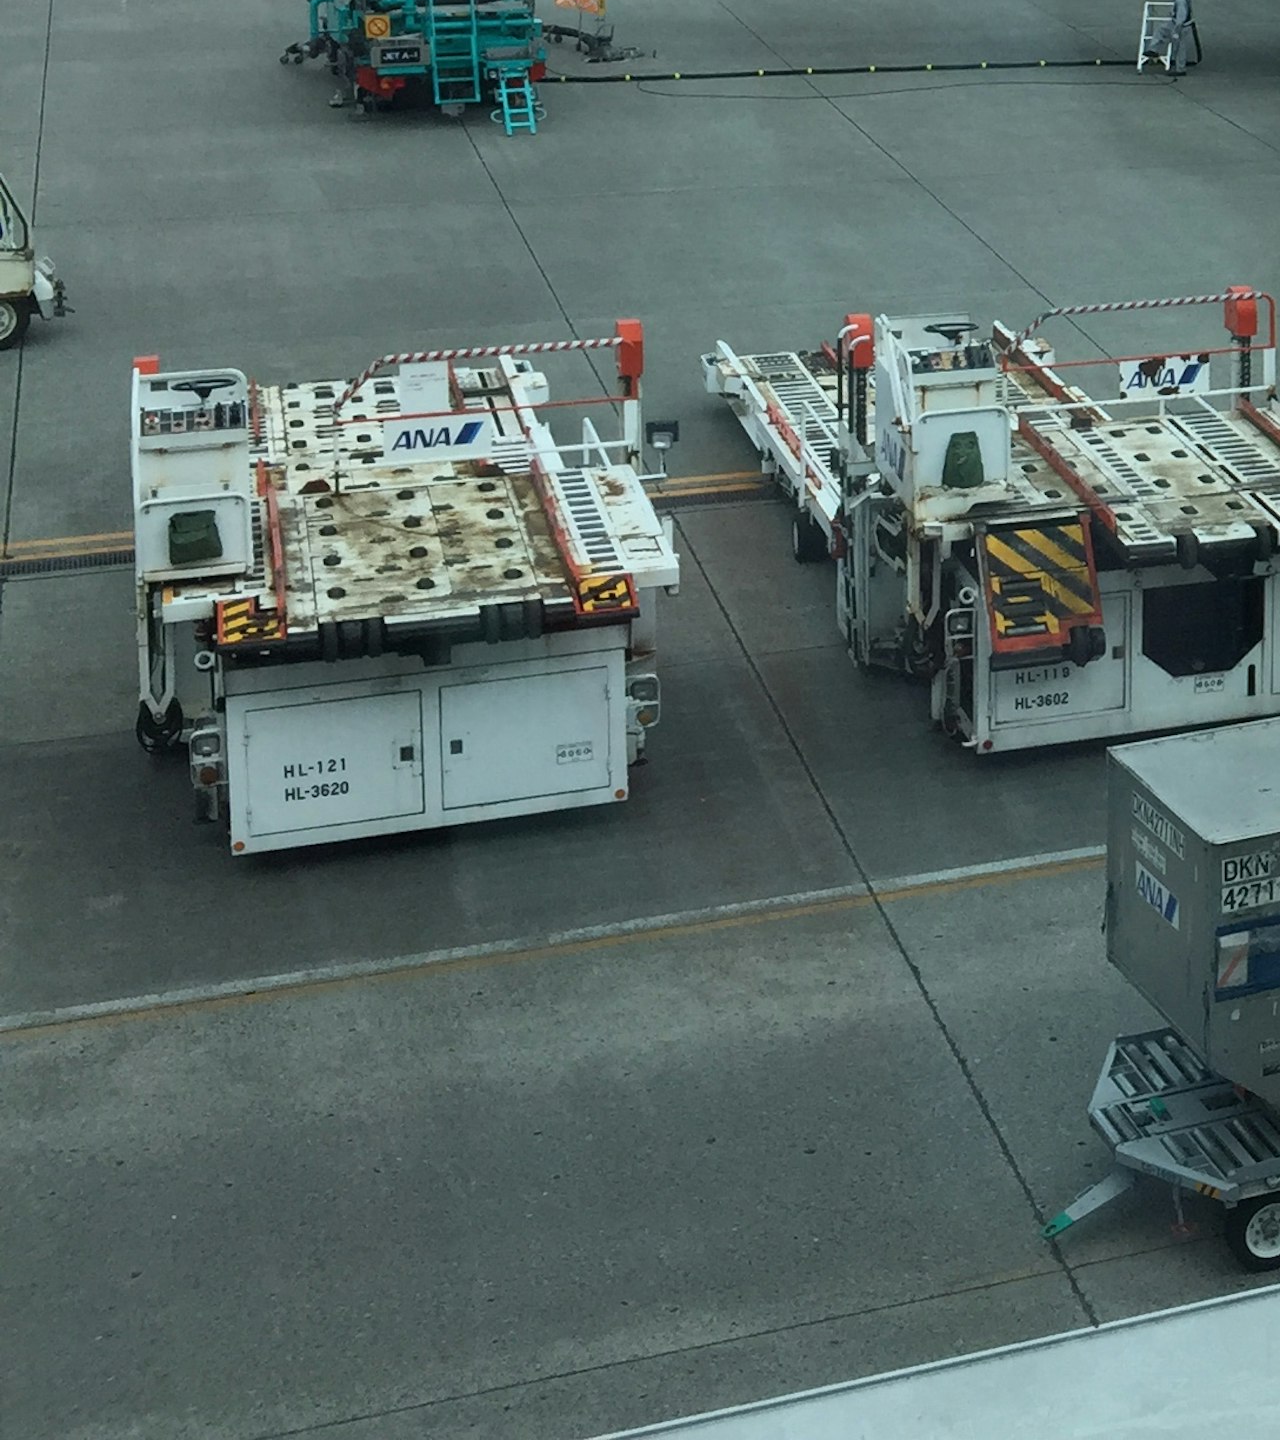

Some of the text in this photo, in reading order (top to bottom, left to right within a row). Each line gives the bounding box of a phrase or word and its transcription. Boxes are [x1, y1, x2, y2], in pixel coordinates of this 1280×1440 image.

[383, 52, 399, 60] JET
[1126, 368, 1176, 390] ANA
[391, 427, 451, 451] ANA
[1014, 691, 1070, 710] HL-3602
[284, 757, 346, 779] HL-121
[284, 781, 349, 802] HL-3620
[1224, 854, 1270, 882] DKN
[1137, 870, 1163, 913] ANA
